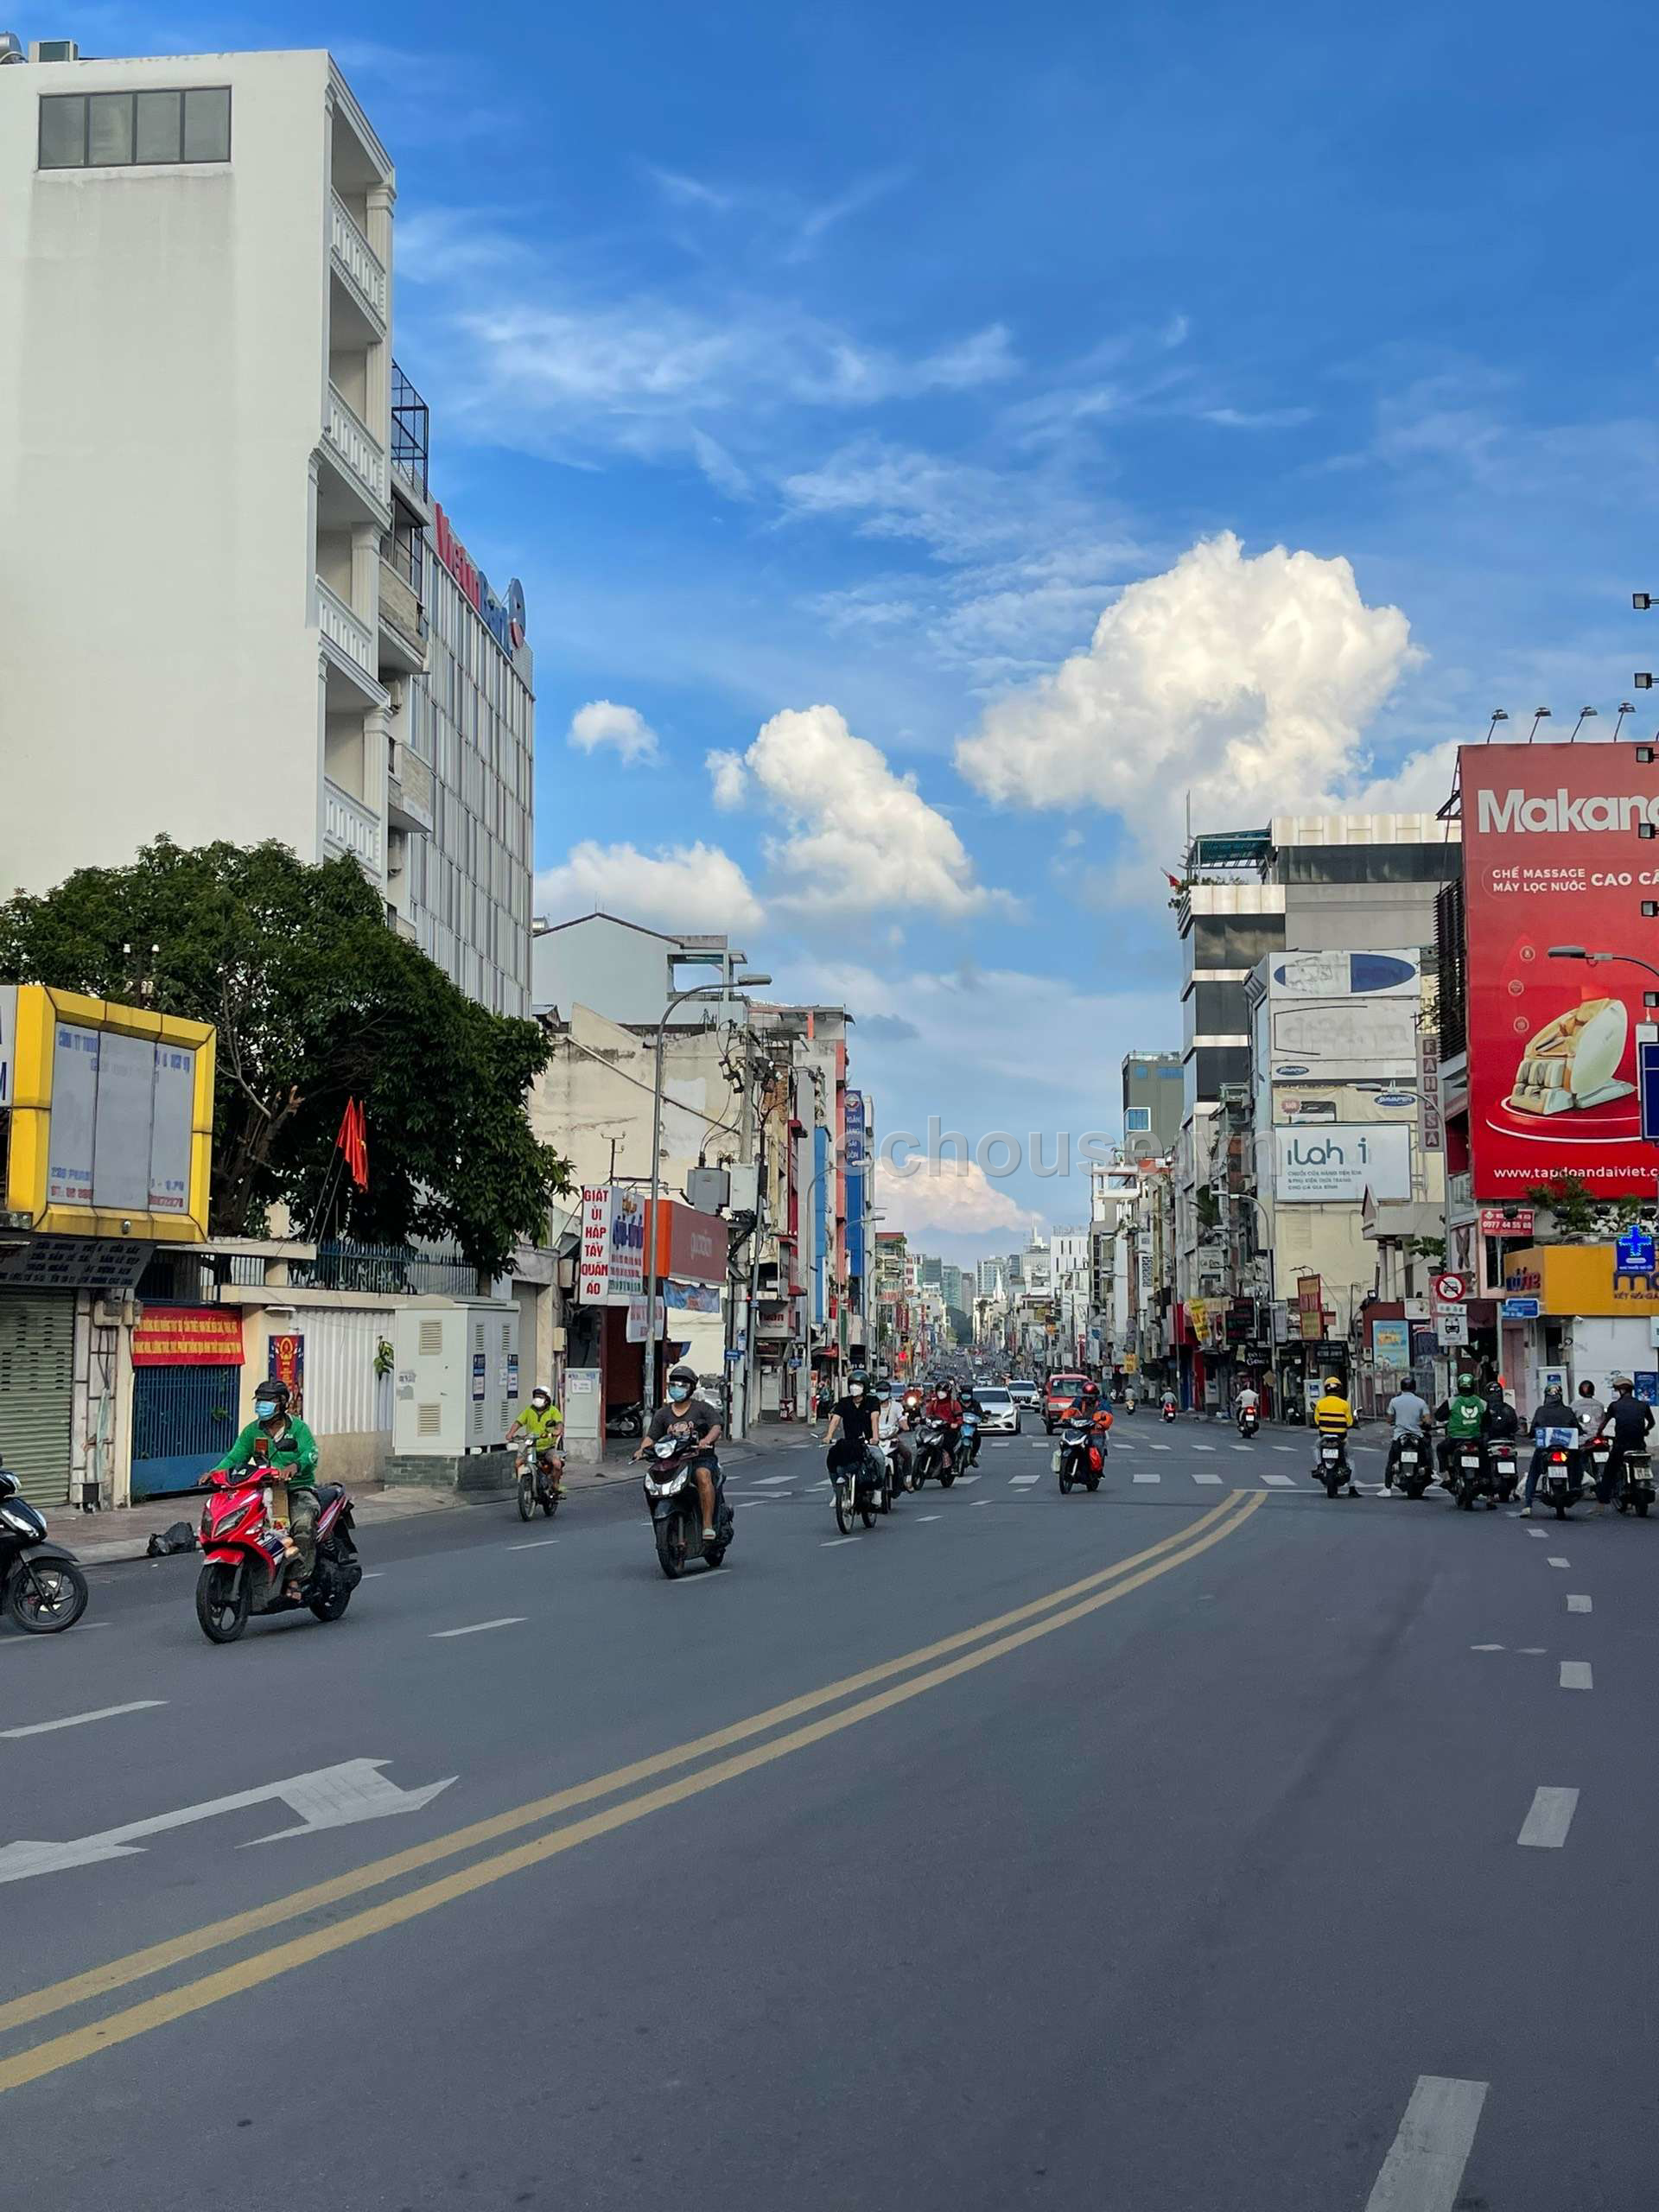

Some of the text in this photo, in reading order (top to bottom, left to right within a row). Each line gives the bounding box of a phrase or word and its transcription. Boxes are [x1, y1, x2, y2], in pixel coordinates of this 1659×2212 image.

[1492, 867, 1586, 879] GHẾ MASSAGE
[1492, 880, 1587, 893] MÁY LỌC NƯỚC
[1591, 873, 1632, 887] CAO
